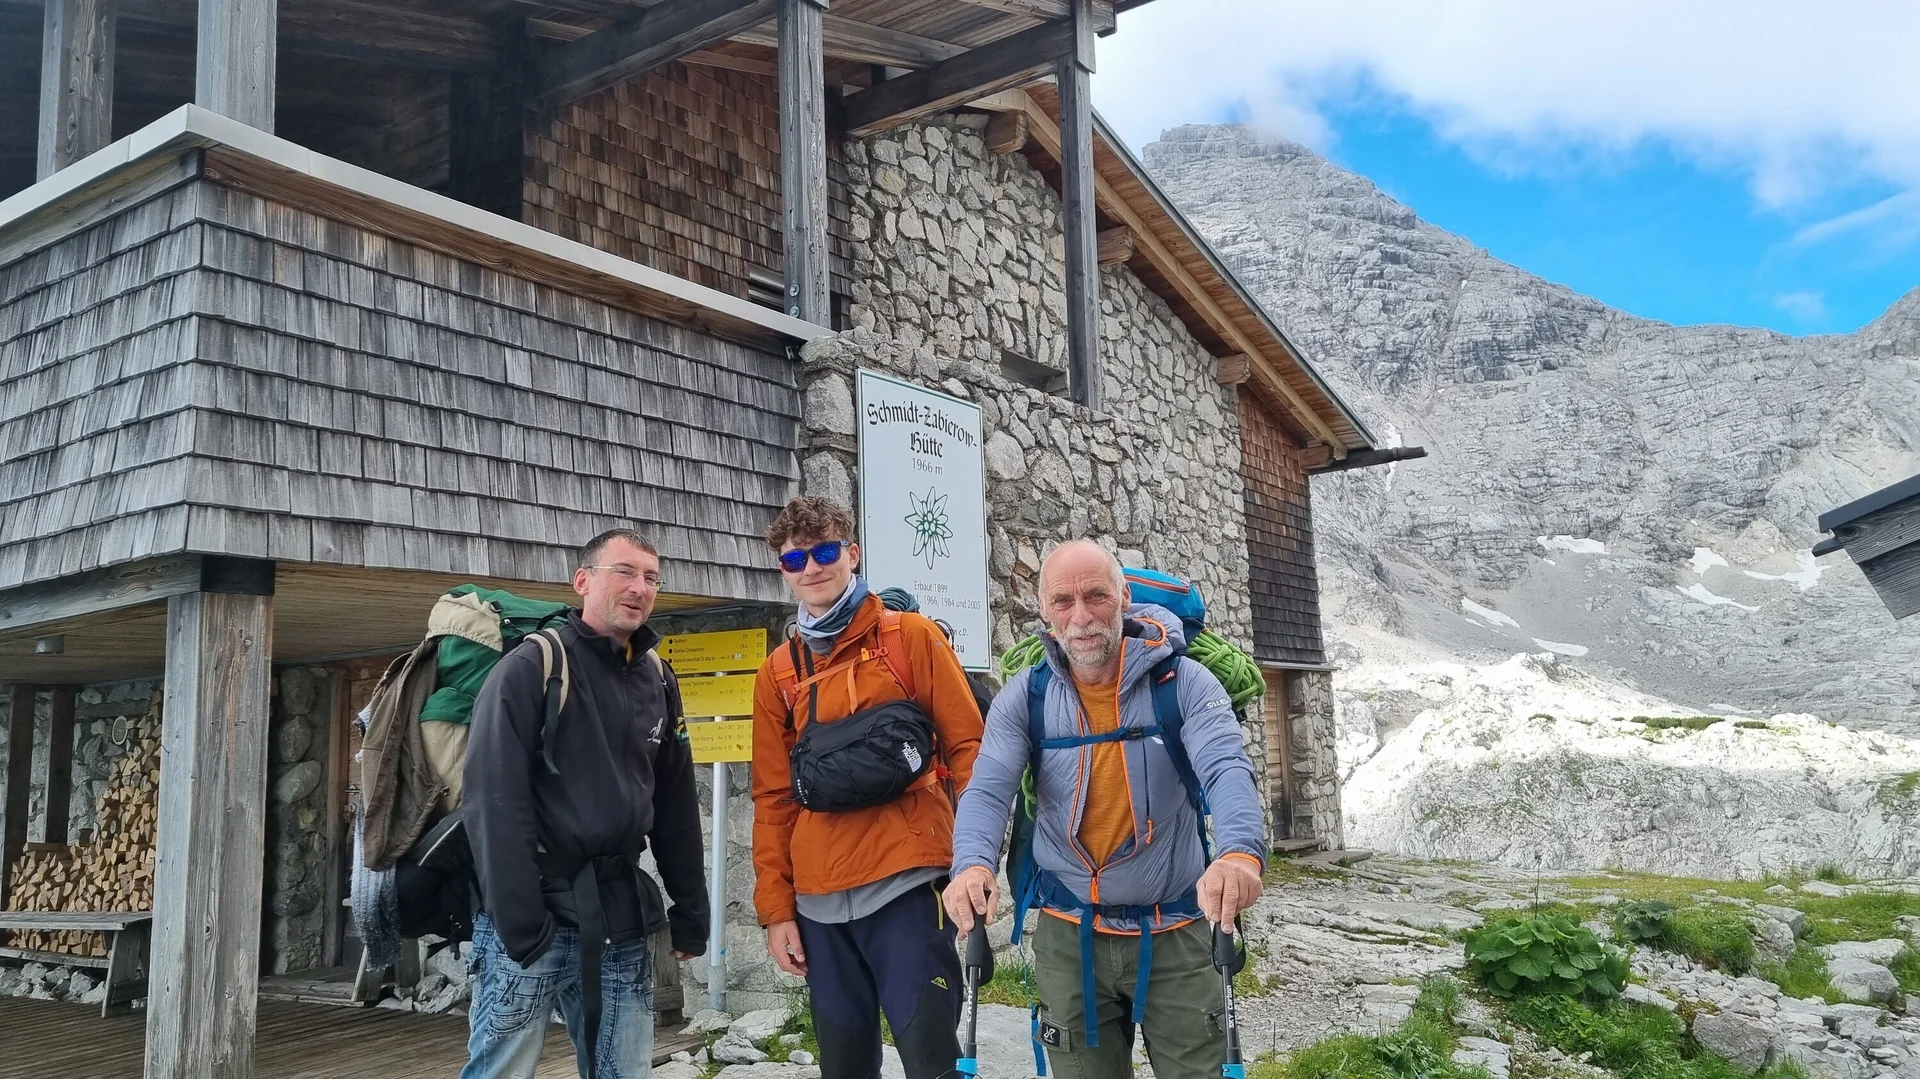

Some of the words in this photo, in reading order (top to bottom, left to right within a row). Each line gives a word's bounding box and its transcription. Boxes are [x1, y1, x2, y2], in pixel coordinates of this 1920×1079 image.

[910, 431, 943, 458] Hütte
[912, 458, 933, 473] 1966
[935, 466, 943, 475] m
[914, 580, 932, 592] Erbaut
[934, 583, 948, 593] 1899
[941, 597, 955, 608] 1984
[956, 600, 966, 609] und
